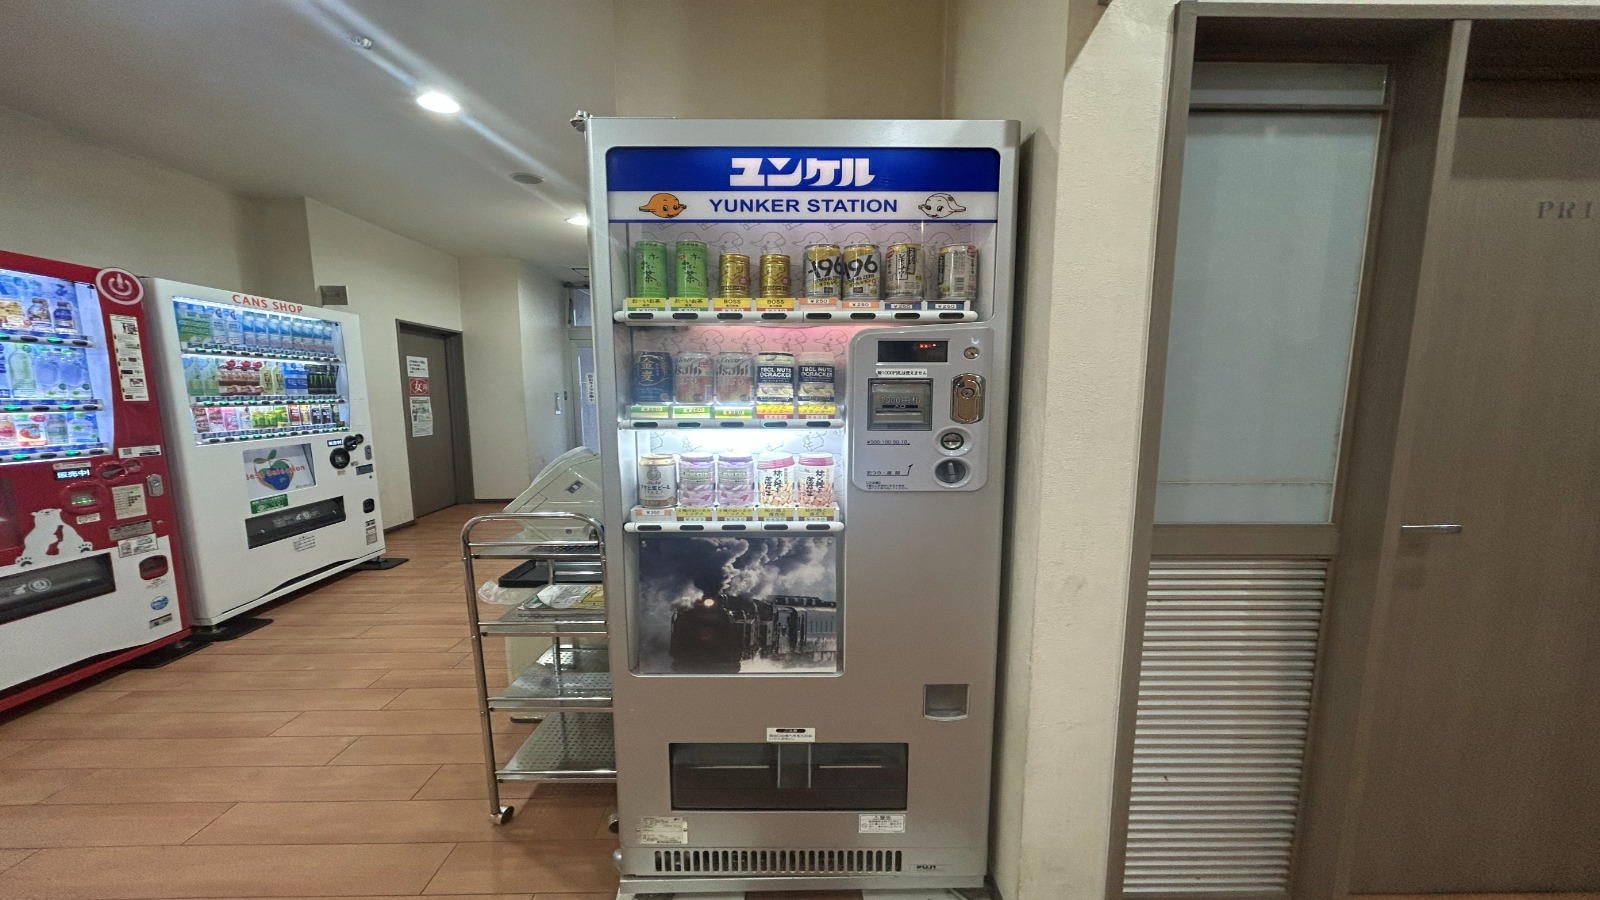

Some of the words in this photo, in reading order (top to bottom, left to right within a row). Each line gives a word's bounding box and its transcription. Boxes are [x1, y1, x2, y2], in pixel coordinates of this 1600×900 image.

[729, 157, 876, 187] ユンケル
[709, 199, 800, 212] YUNKER
[807, 199, 897, 212] STATION
[1537, 200, 1592, 219] PRI
[232, 294, 268, 309] CANS
[272, 301, 303, 313] SHOP
[641, 358, 655, 382] 金麦
